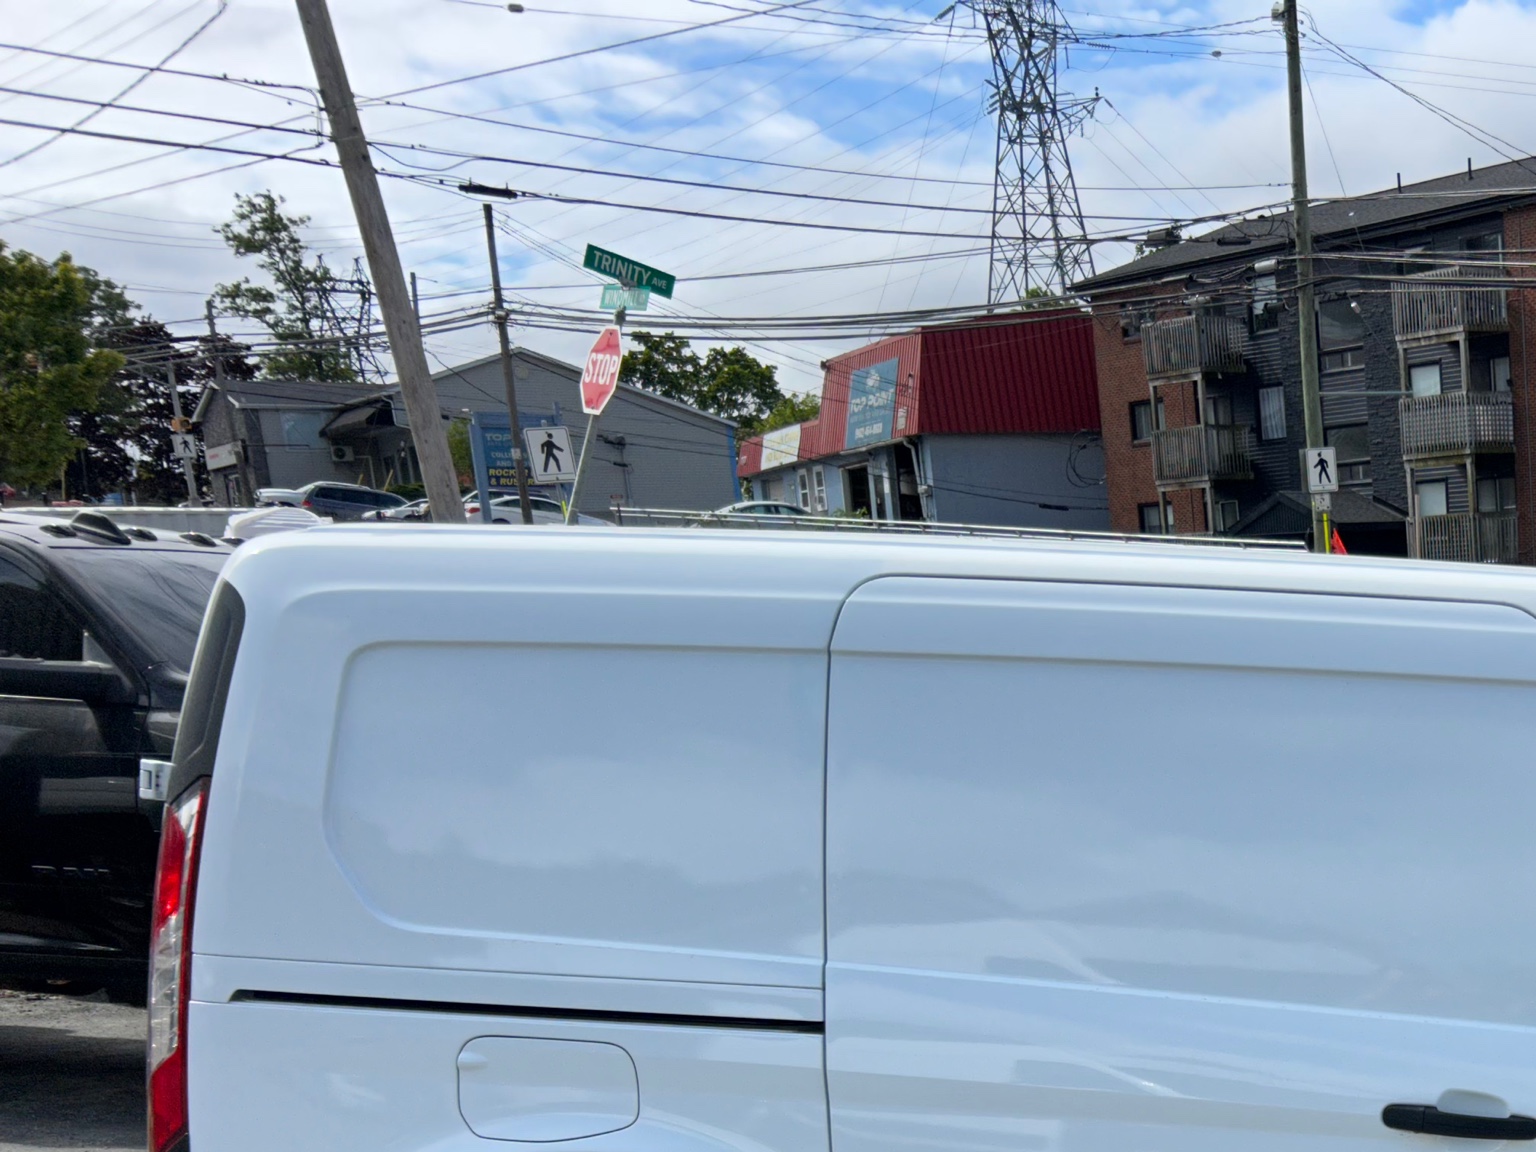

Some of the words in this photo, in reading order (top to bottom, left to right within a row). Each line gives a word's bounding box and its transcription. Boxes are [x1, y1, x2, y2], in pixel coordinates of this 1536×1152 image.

[593, 250, 652, 285] TRINITY
[651, 277, 668, 290] AVE
[605, 289, 637, 306] WINDMILL
[584, 353, 618, 386] STOP
[850, 396, 866, 413] TOP
[489, 468, 528, 476] ROCKR
[490, 477, 497, 485] &
